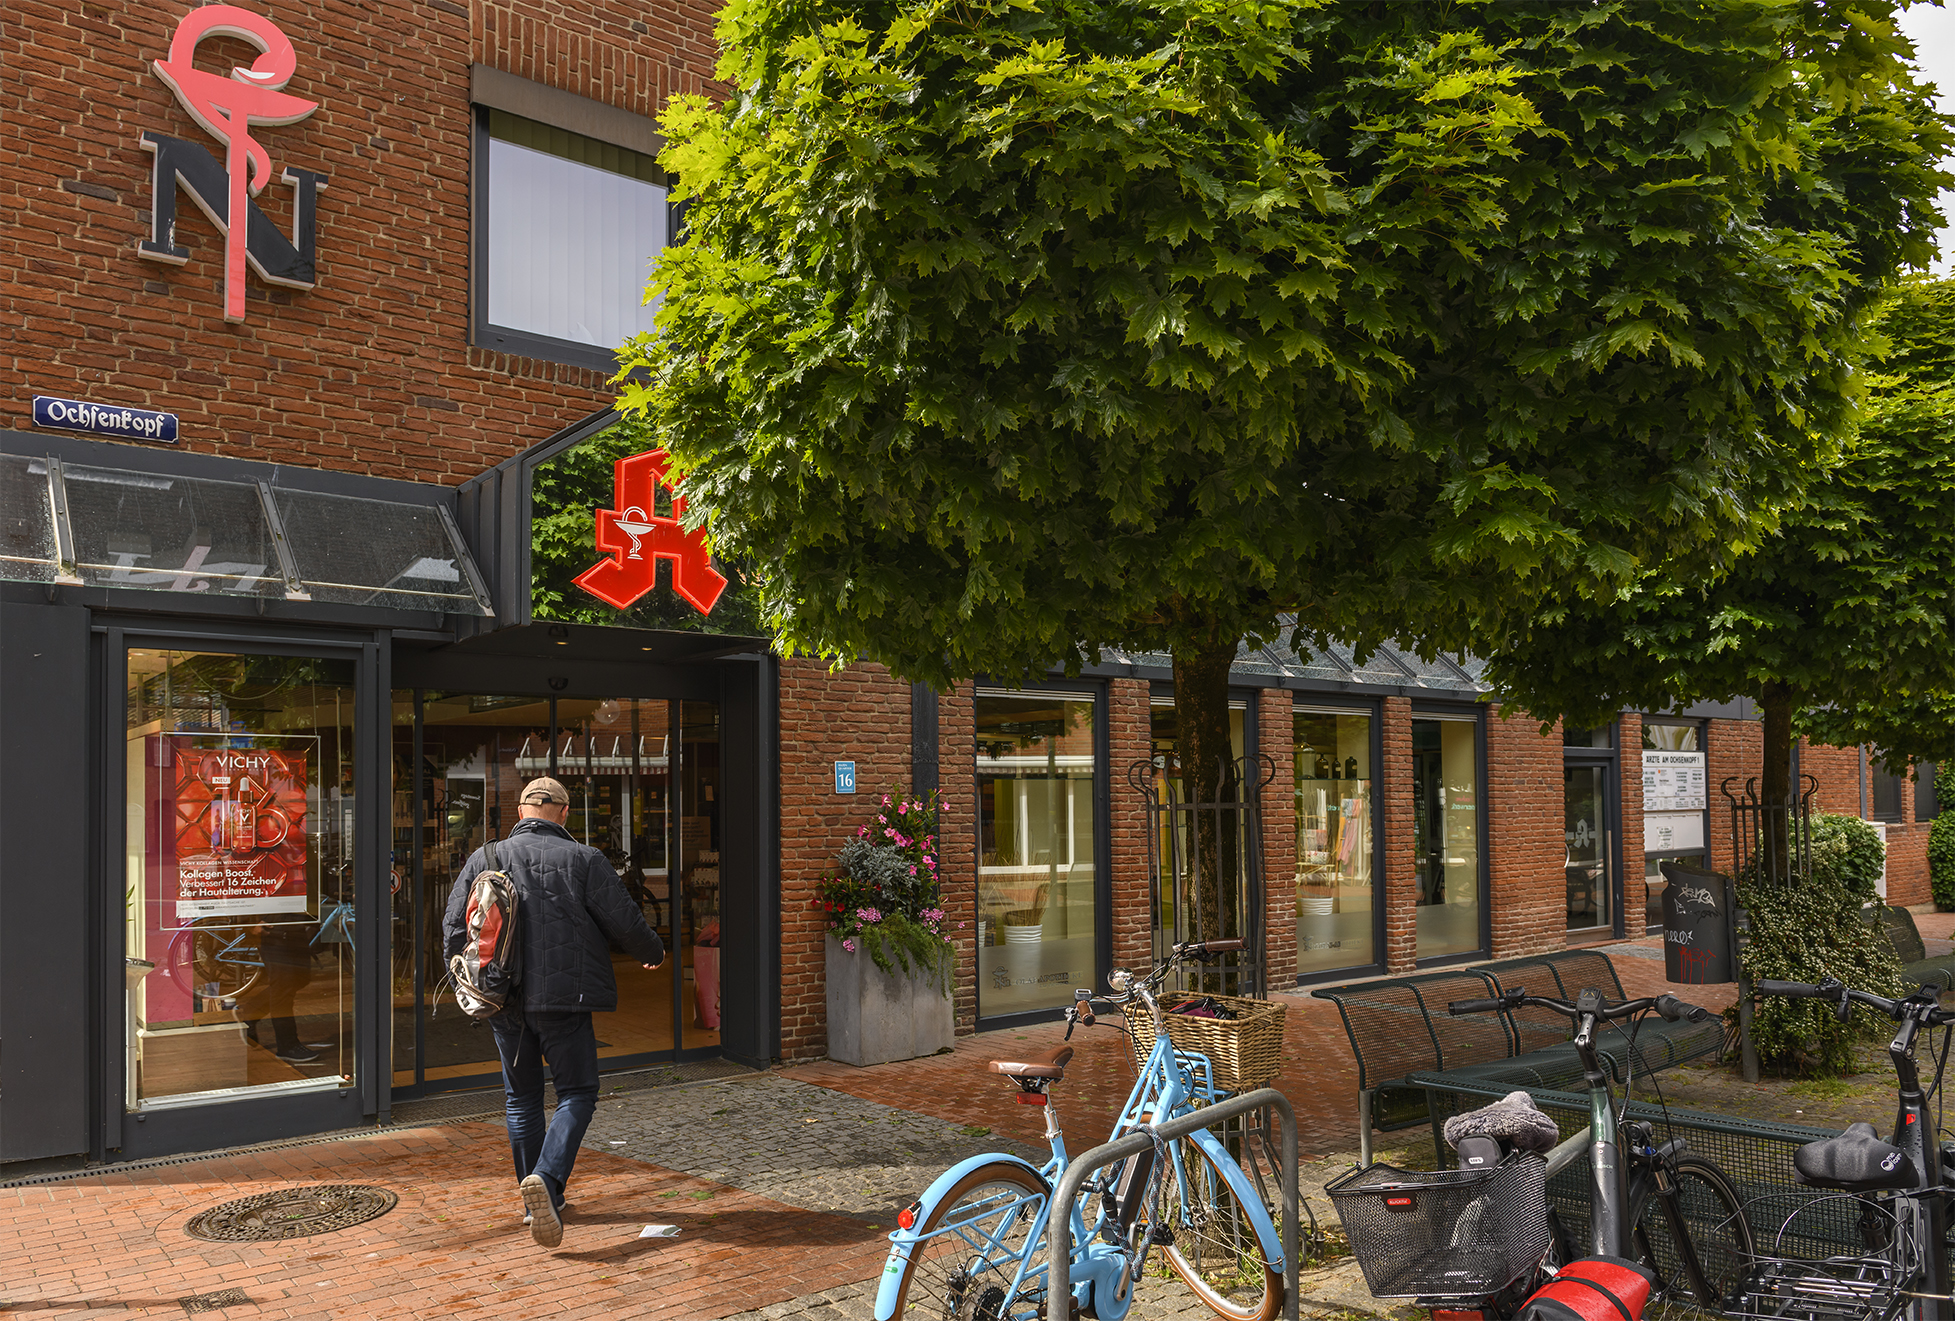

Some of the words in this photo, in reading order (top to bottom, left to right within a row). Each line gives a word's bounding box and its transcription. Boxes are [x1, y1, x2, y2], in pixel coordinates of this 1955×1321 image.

[216, 756, 270, 768] VICHY
[838, 773, 853, 787] 16
[180, 869, 223, 880] Kollagen
[180, 879, 225, 888] Verbessert
[241, 877, 277, 886] Zeichen
[180, 889, 197, 897] der
